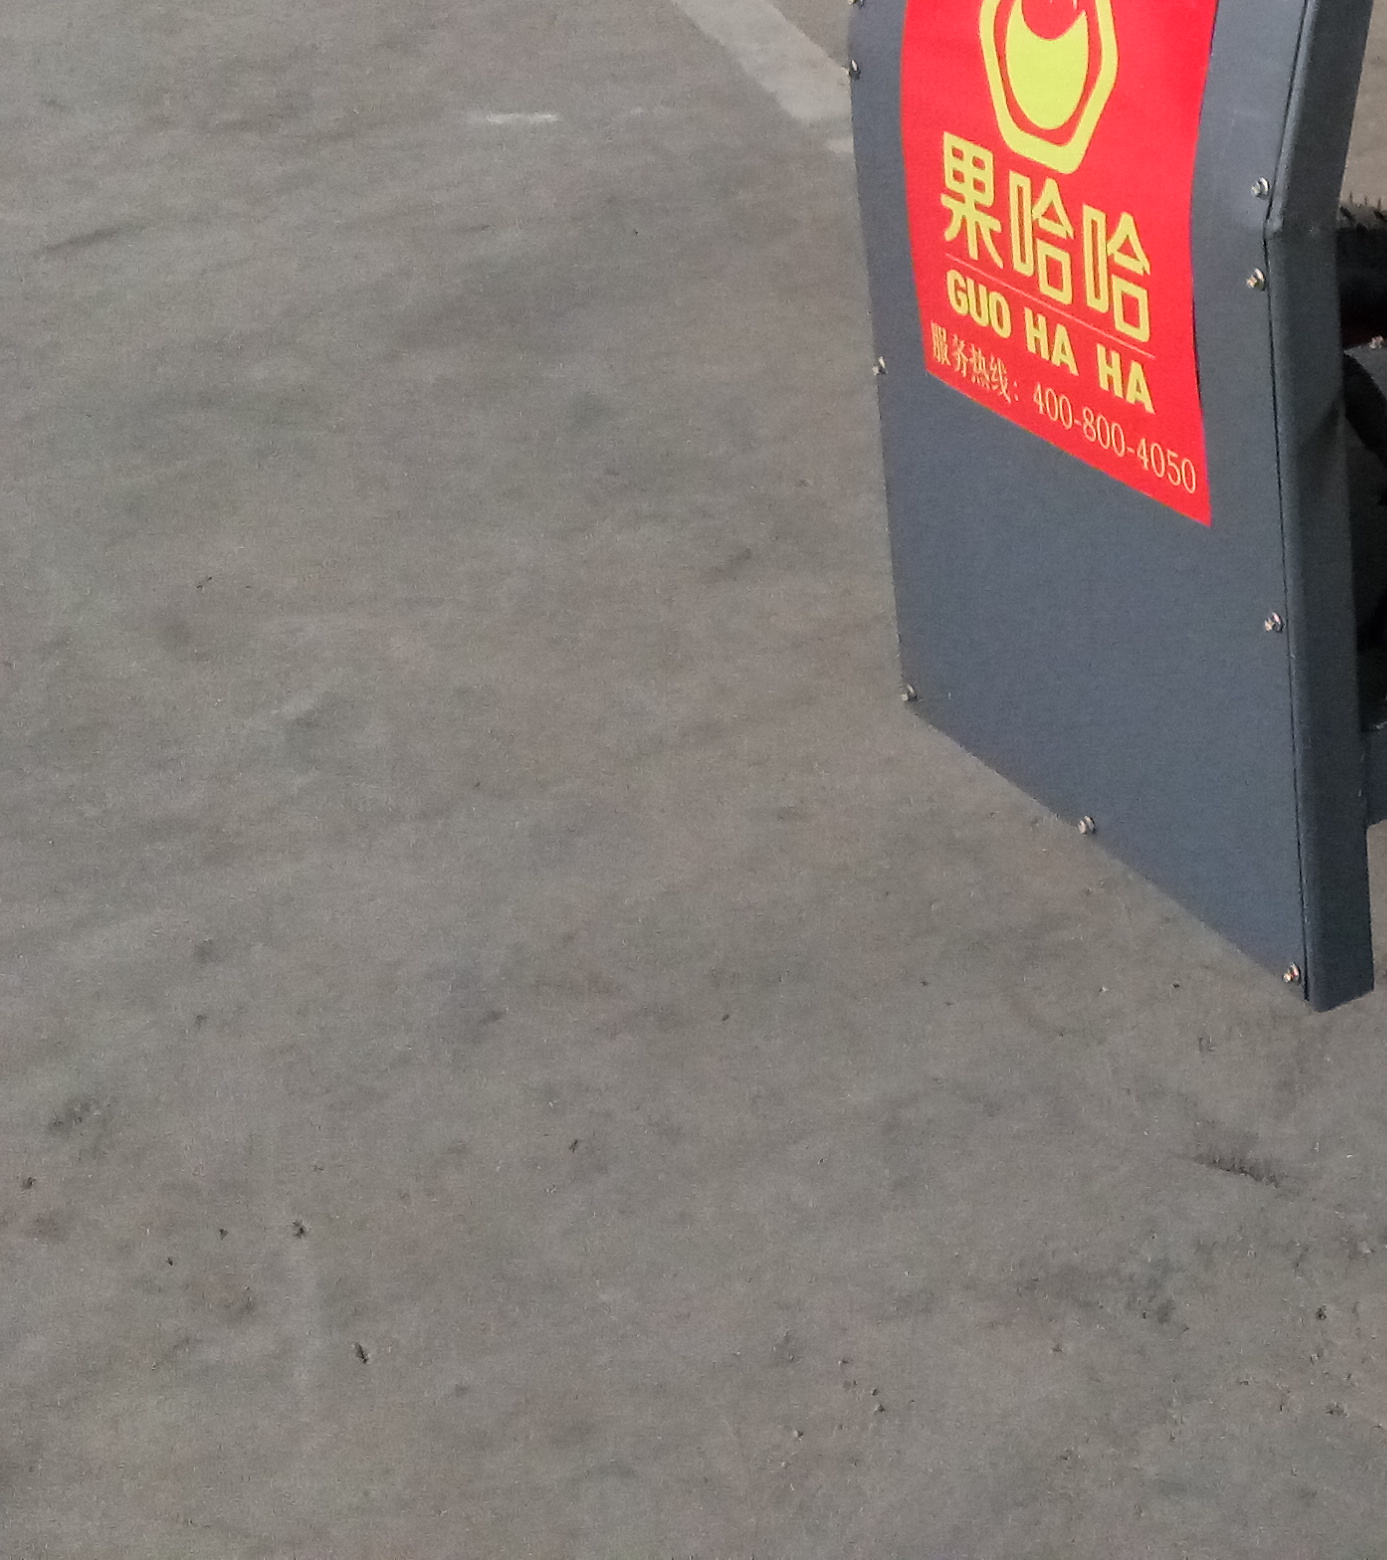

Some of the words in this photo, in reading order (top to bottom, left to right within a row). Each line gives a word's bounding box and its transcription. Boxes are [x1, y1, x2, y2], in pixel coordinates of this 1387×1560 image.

[940, 131, 1152, 343] 果哈哈
[946, 269, 1012, 339] GUO
[1024, 306, 1079, 377] HA
[1096, 343, 1156, 415] HA
[1033, 382, 1197, 494] 400-800-4050
